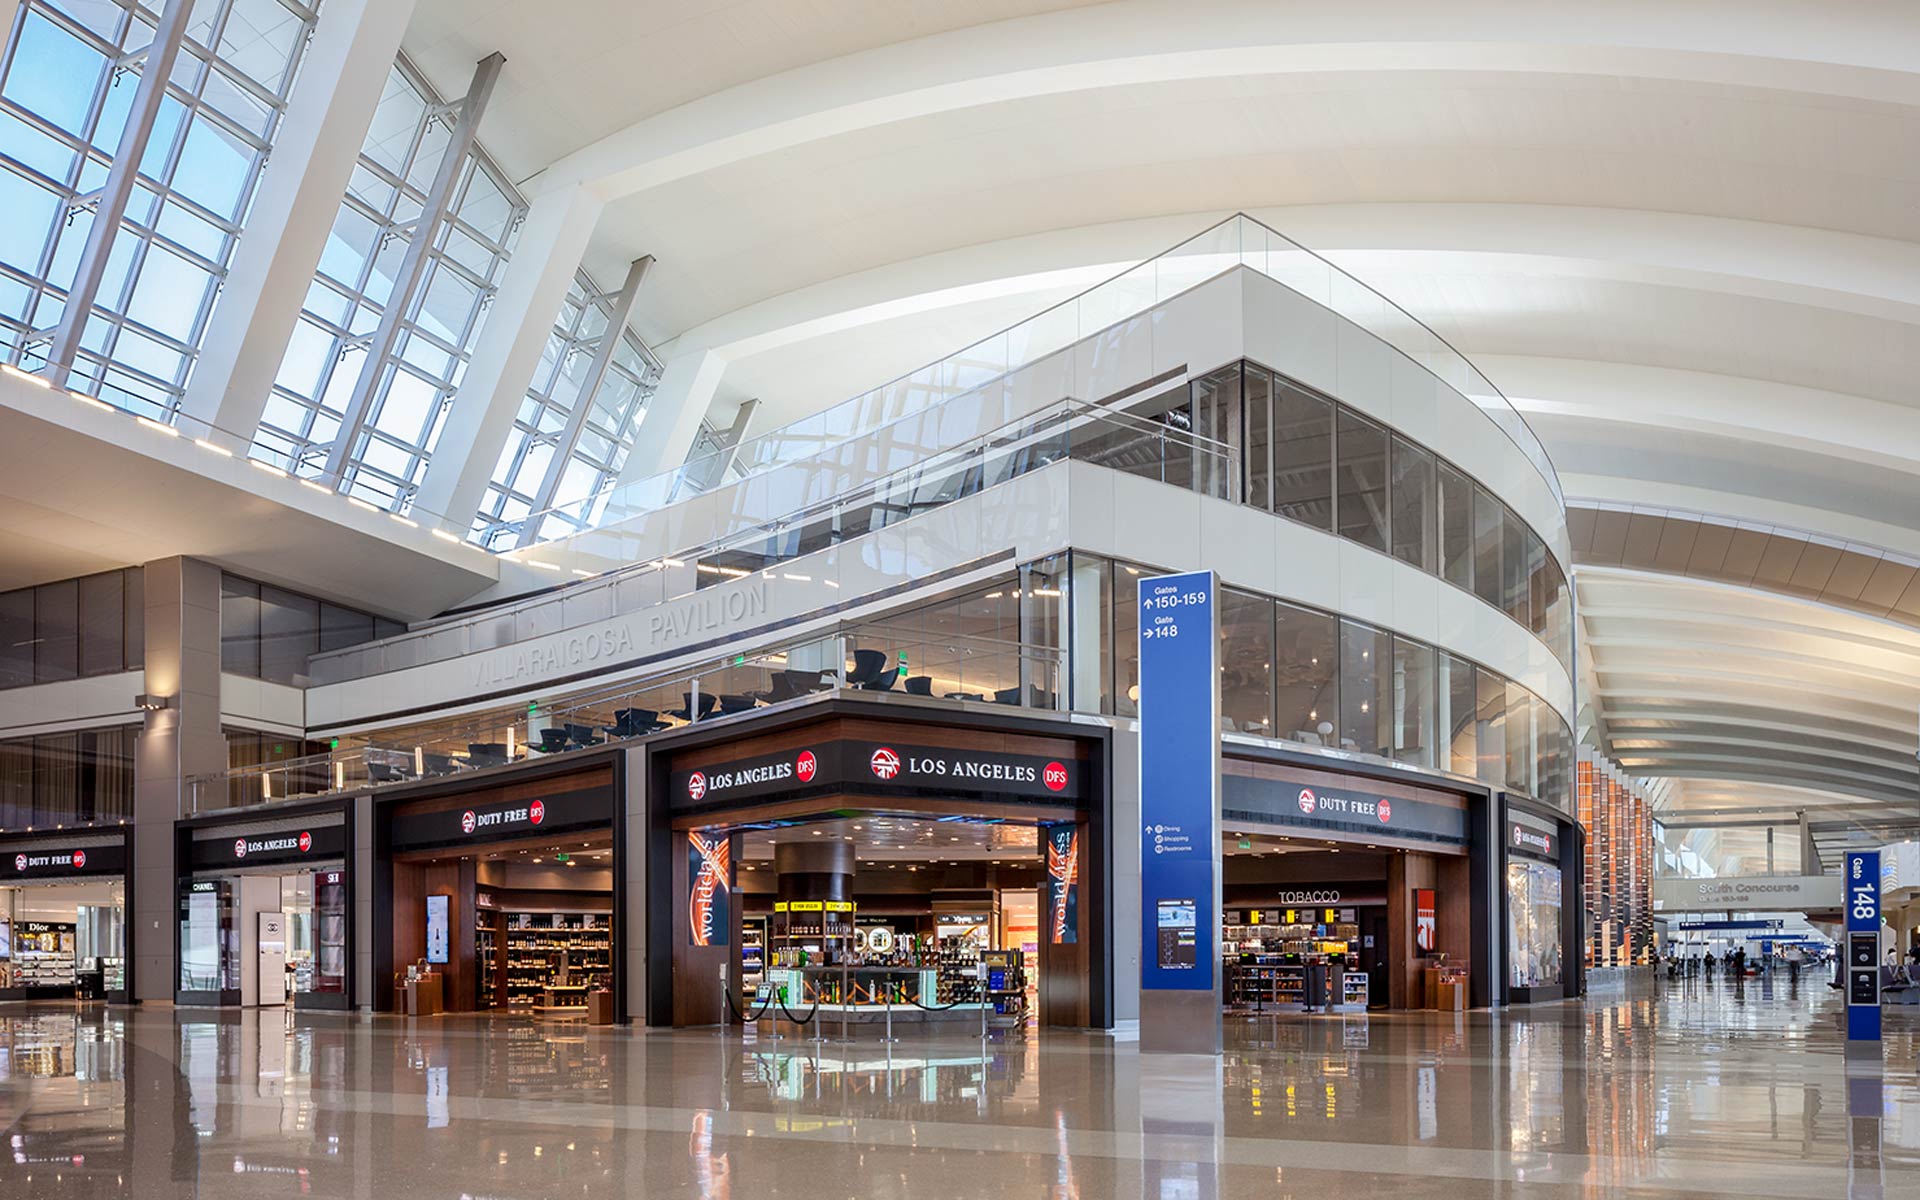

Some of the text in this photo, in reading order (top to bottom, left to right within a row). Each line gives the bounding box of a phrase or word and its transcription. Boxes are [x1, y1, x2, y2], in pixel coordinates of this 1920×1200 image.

[1154, 586, 1178, 595] Gates
[1155, 591, 1206, 608] 150-159
[1154, 616, 1174, 625] Gate
[470, 582, 766, 686] VILLARAIGOSA PAVILION
[1155, 625, 1178, 638] 148
[709, 759, 814, 790] LOS ANGELES DFS
[909, 757, 1066, 783] LOS ANGELES DFS
[1320, 797, 1348, 811] DUTY
[1350, 801, 1376, 815] FREE
[478, 807, 542, 827] DUTY FREE DFS
[248, 842, 263, 852] LOS
[264, 838, 298, 850] ANGELES
[29, 857, 50, 866] DUTY
[52, 855, 71, 865] FREE
[1852, 857, 1864, 879] Gate
[193, 882, 214, 891] CHANEL
[697, 840, 713, 939] worldclass
[1054, 832, 1066, 936] worldclass
[1699, 882, 1800, 894] South Concourse
[1278, 890, 1340, 904] TOBACCO
[1852, 883, 1875, 919] 148
[29, 923, 49, 931] Dior
